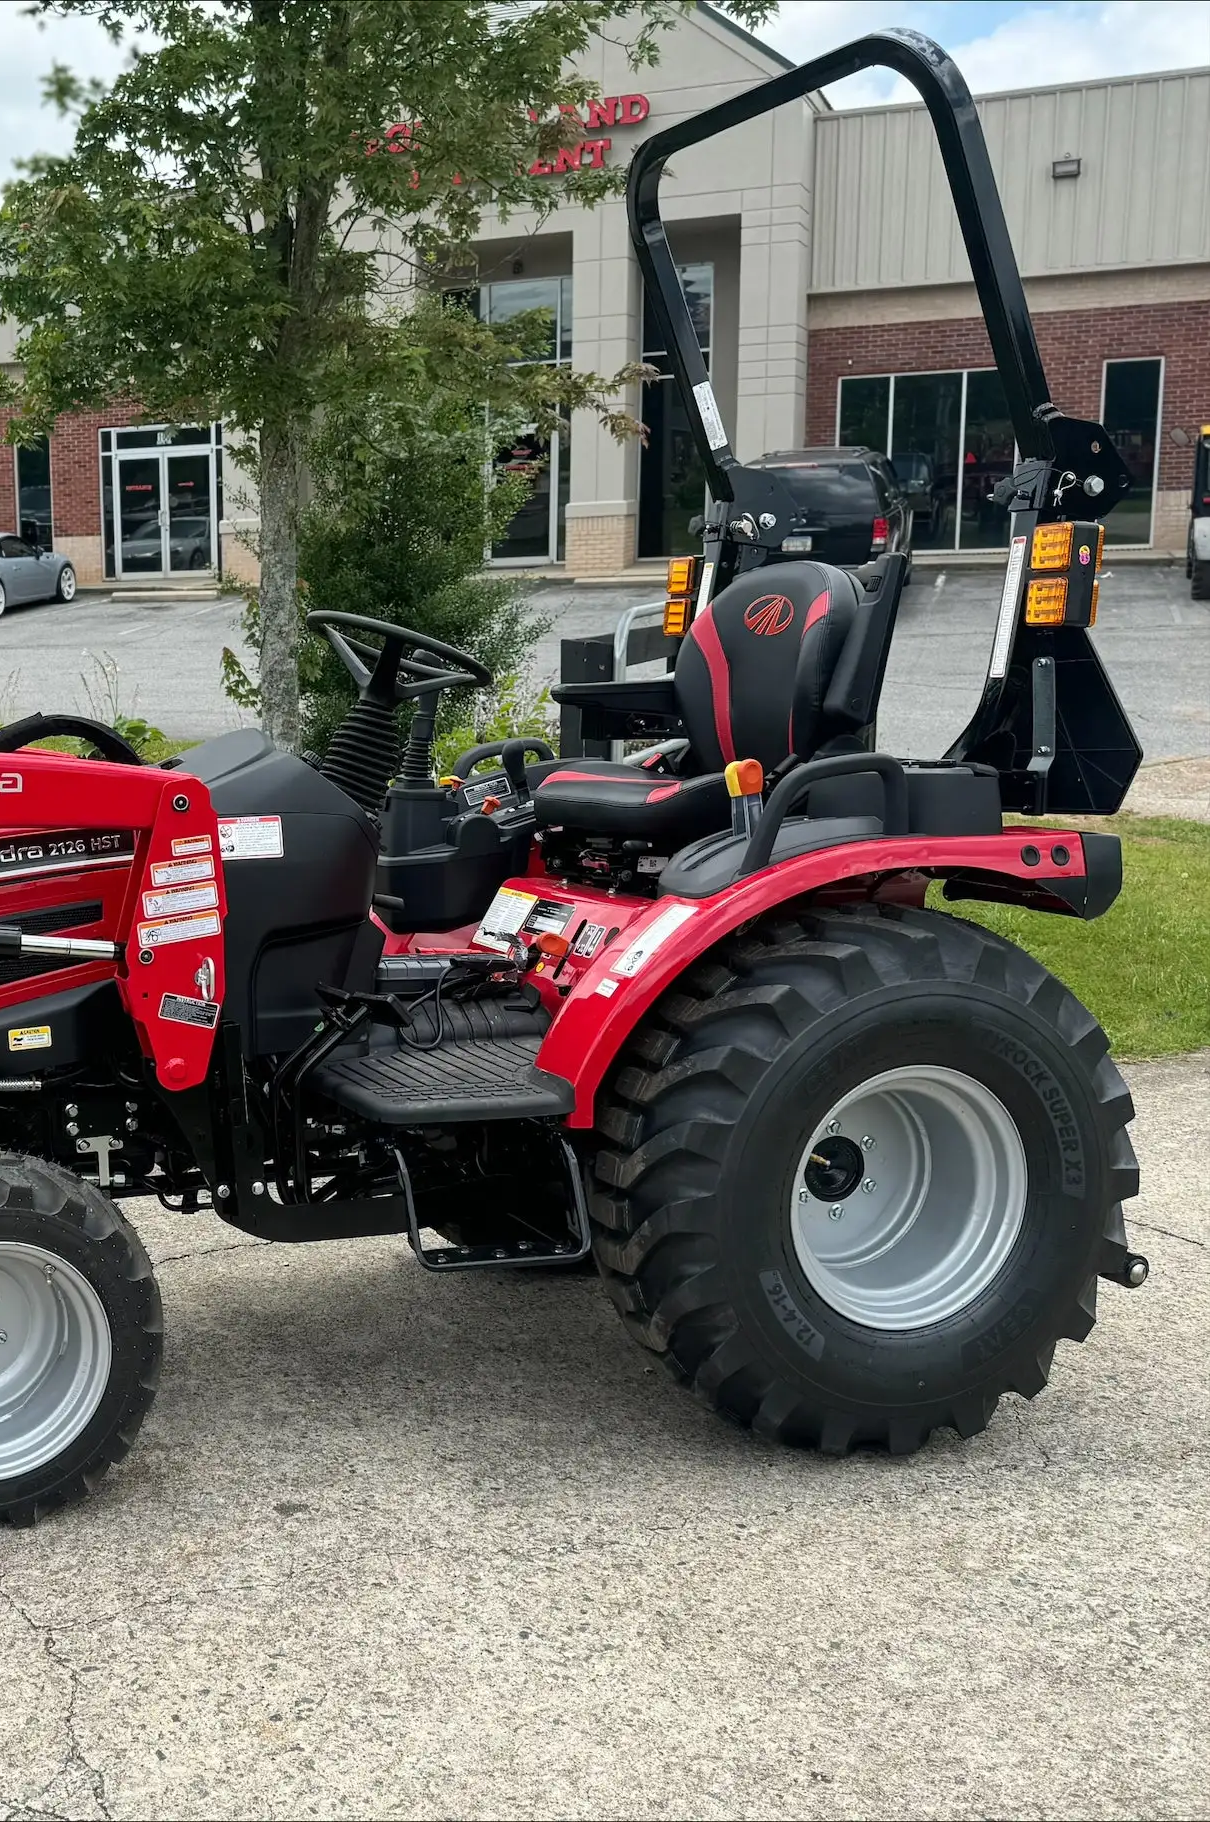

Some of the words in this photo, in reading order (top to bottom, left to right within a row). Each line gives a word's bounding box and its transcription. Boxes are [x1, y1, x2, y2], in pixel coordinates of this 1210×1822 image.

[48, 839, 87, 857] 2126
[90, 834, 121, 852] HST
[1042, 1085, 1080, 1153] SUPER
[1064, 1158, 1083, 1186] X3
[766, 1283, 816, 1347] 12.4-16
